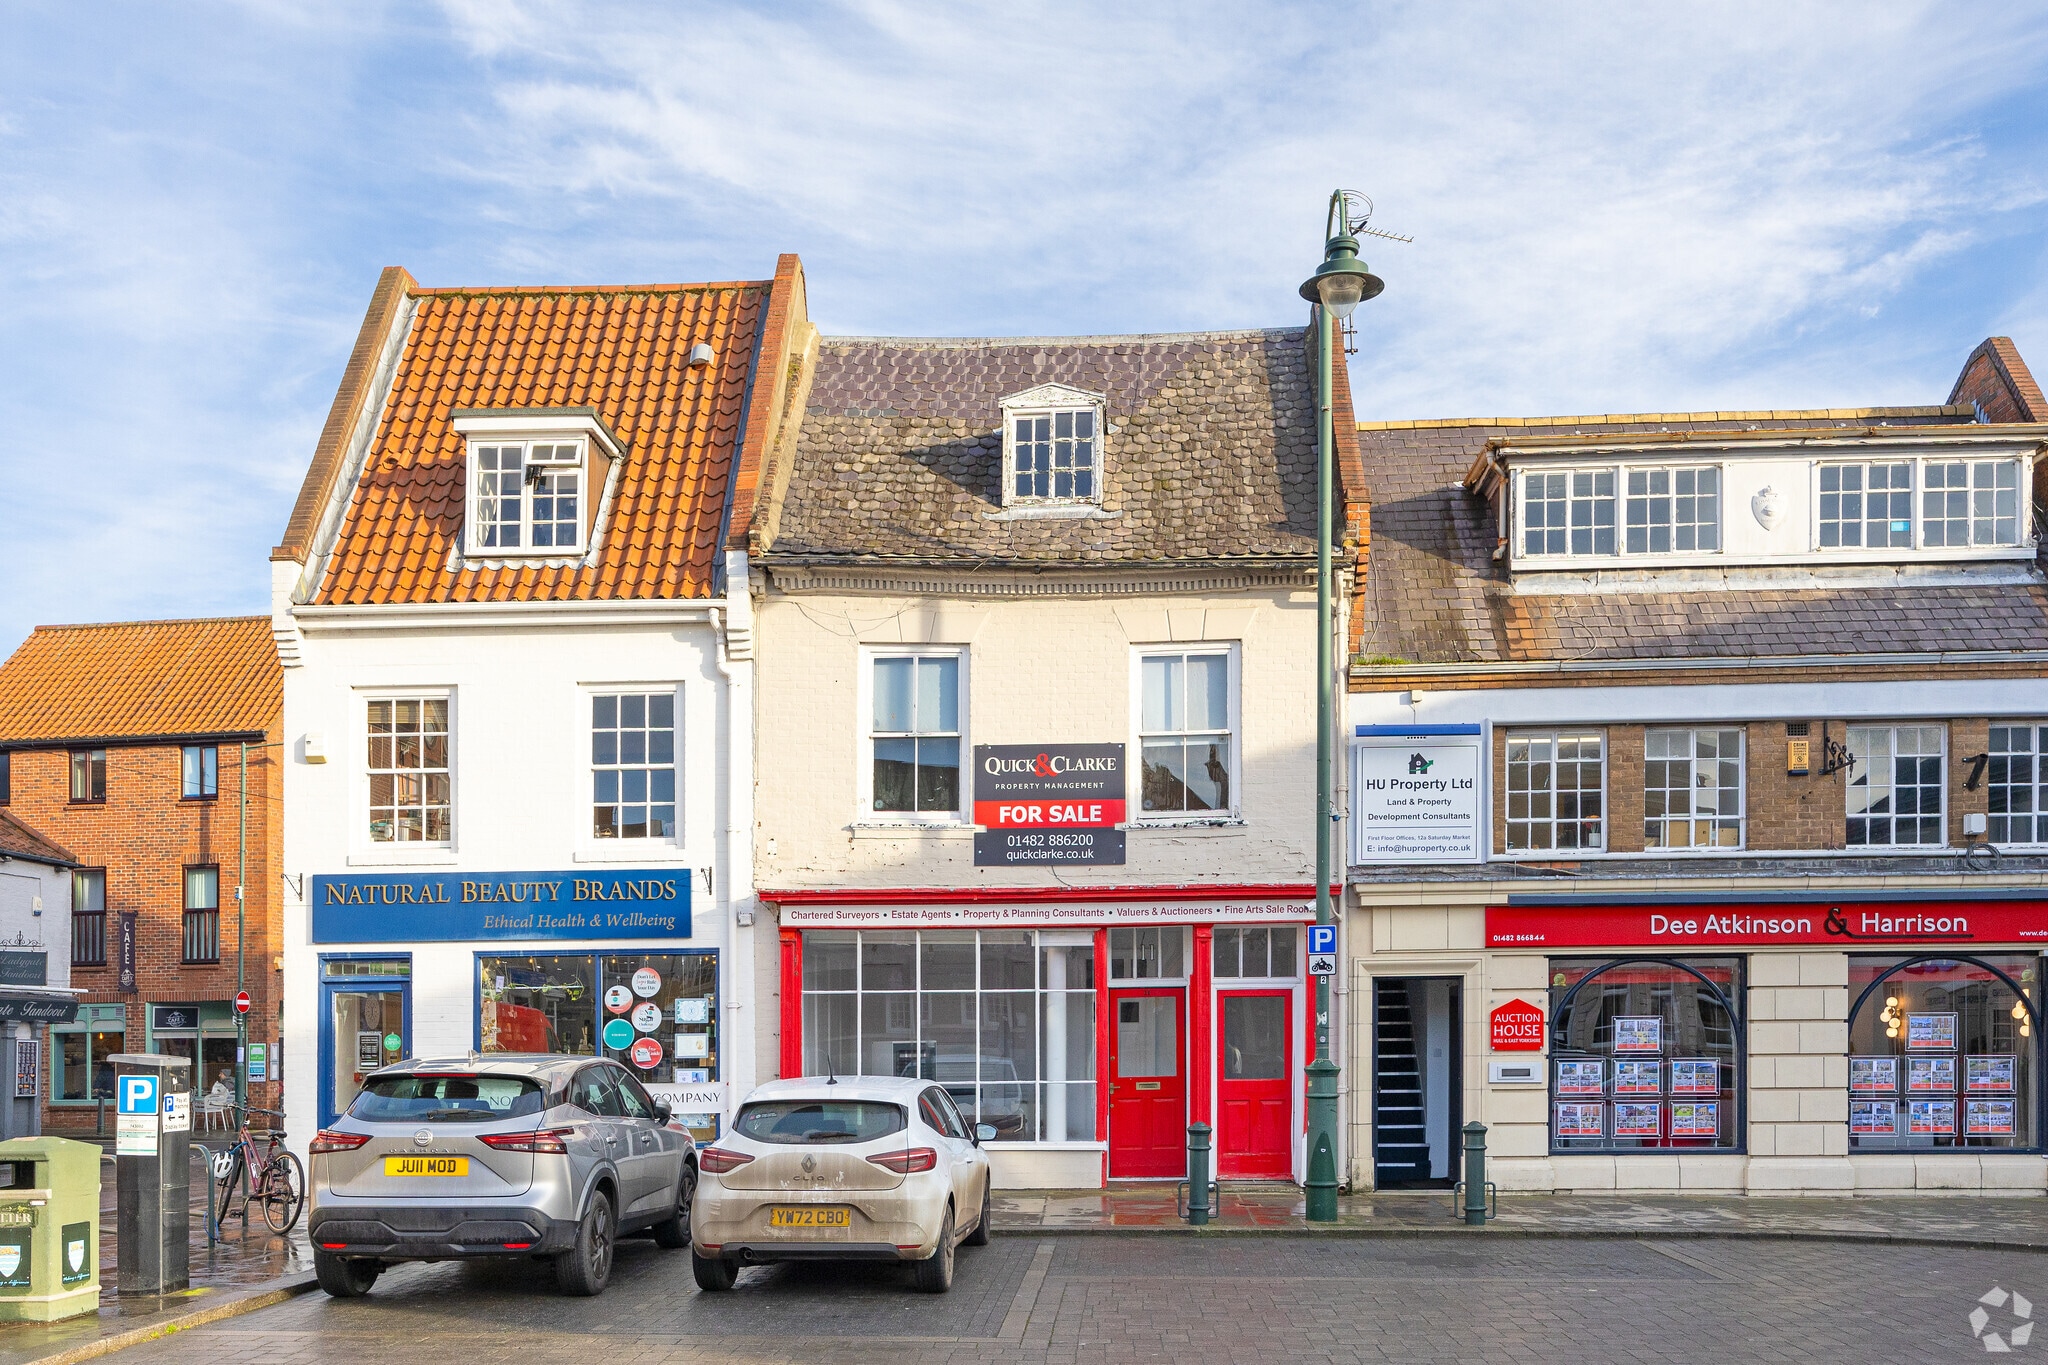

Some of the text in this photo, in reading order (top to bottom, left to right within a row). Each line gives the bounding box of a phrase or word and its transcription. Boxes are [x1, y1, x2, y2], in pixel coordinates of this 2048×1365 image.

[1366, 778, 1472, 791] HU Property Ltd
[1000, 805, 1102, 823] FOR SALE
[1368, 813, 1420, 821] Development
[1008, 834, 1093, 846] 01482 886200
[1006, 849, 1094, 861] quickclarke.co.uk
[1378, 845, 1471, 853] info@huproperty.co.uk
[326, 879, 677, 905] NATURAL BEAUTY BRANDS
[791, 910, 834, 920] Chartered
[836, 910, 880, 921] Surveyors
[891, 910, 918, 919] Estate
[921, 910, 951, 920] Agents
[963, 910, 1000, 920] Property
[1003, 909, 1009, 918] &
[1012, 909, 1050, 919] Planning
[1052, 908, 1104, 917] Consultants
[1116, 908, 1150, 917] Valuers
[1152, 908, 1158, 916] &
[1160, 907, 1213, 916] Auctioneers
[1225, 906, 1243, 914] Fine
[1246, 905, 1263, 914] Arts
[1266, 905, 1285, 914] Sale
[483, 913, 676, 930] Ethical Health & Wellbeing
[1650, 914, 1698, 935] Dee
[1702, 914, 1811, 935] Atkinson
[1861, 913, 1968, 933] Harrison
[1315, 929, 1332, 951] P
[20, 1002, 68, 1017] Tandoori
[1494, 1014, 1540, 1022] AUCTION
[1494, 1025, 1540, 1036] HOUSE
[127, 1080, 152, 1111] P
[652, 1092, 720, 1103] COMPANY
[166, 1098, 172, 1110] P
[428, 1160, 456, 1173] MOD
[777, 1211, 812, 1223] YW72
